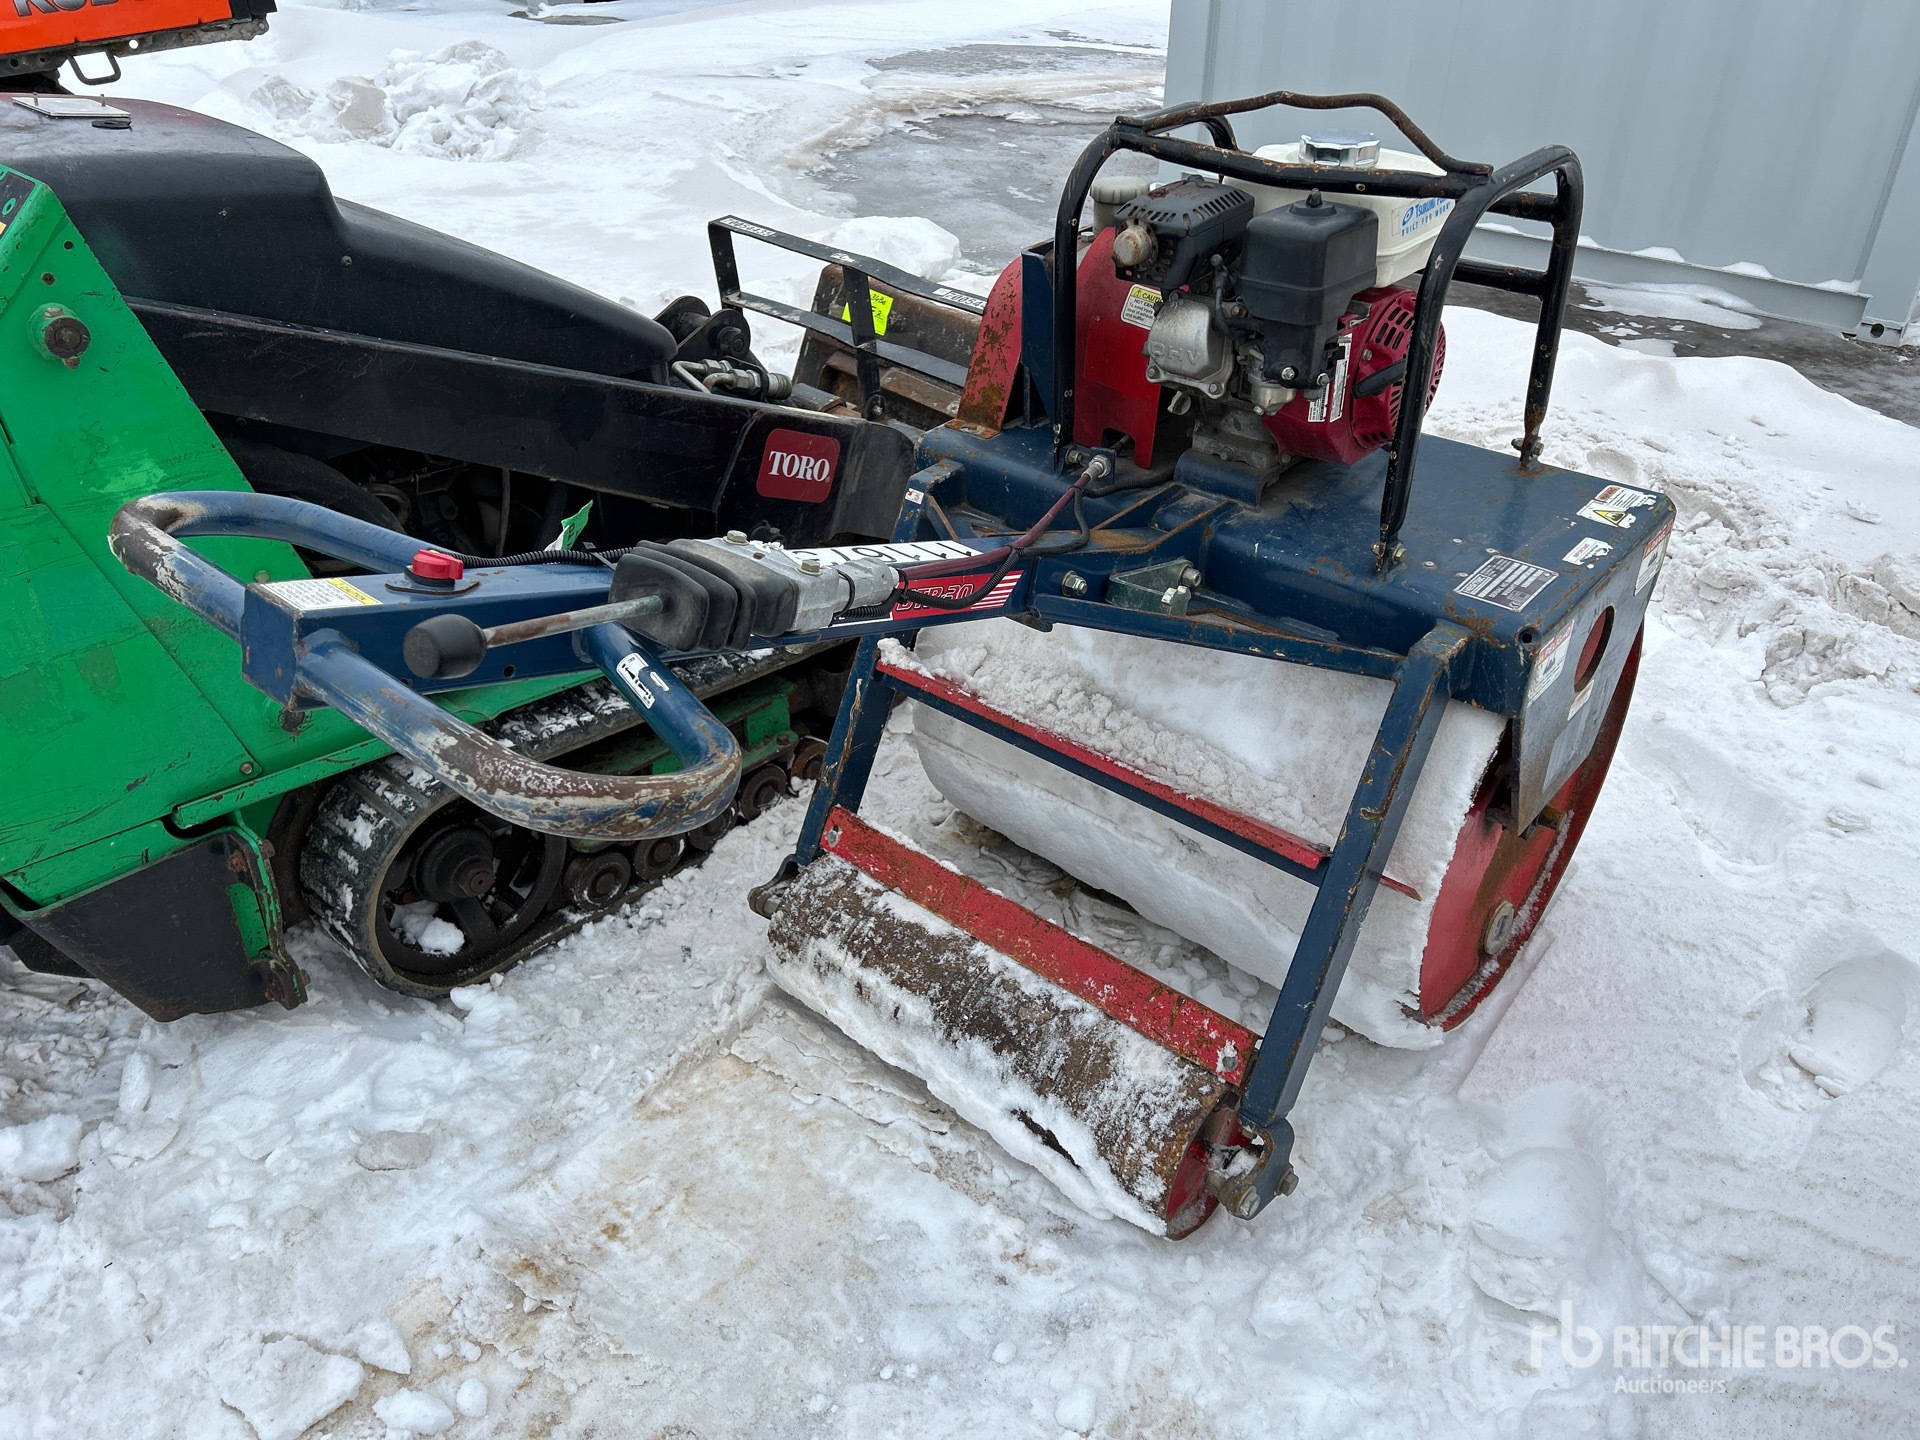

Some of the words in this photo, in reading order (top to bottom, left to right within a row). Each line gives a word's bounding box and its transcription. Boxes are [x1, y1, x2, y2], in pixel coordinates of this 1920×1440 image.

[1402, 221, 1419, 237] BUILT
[1422, 213, 1432, 225] FOR
[1151, 341, 1201, 366] OHV
[768, 451, 830, 482] TORO
